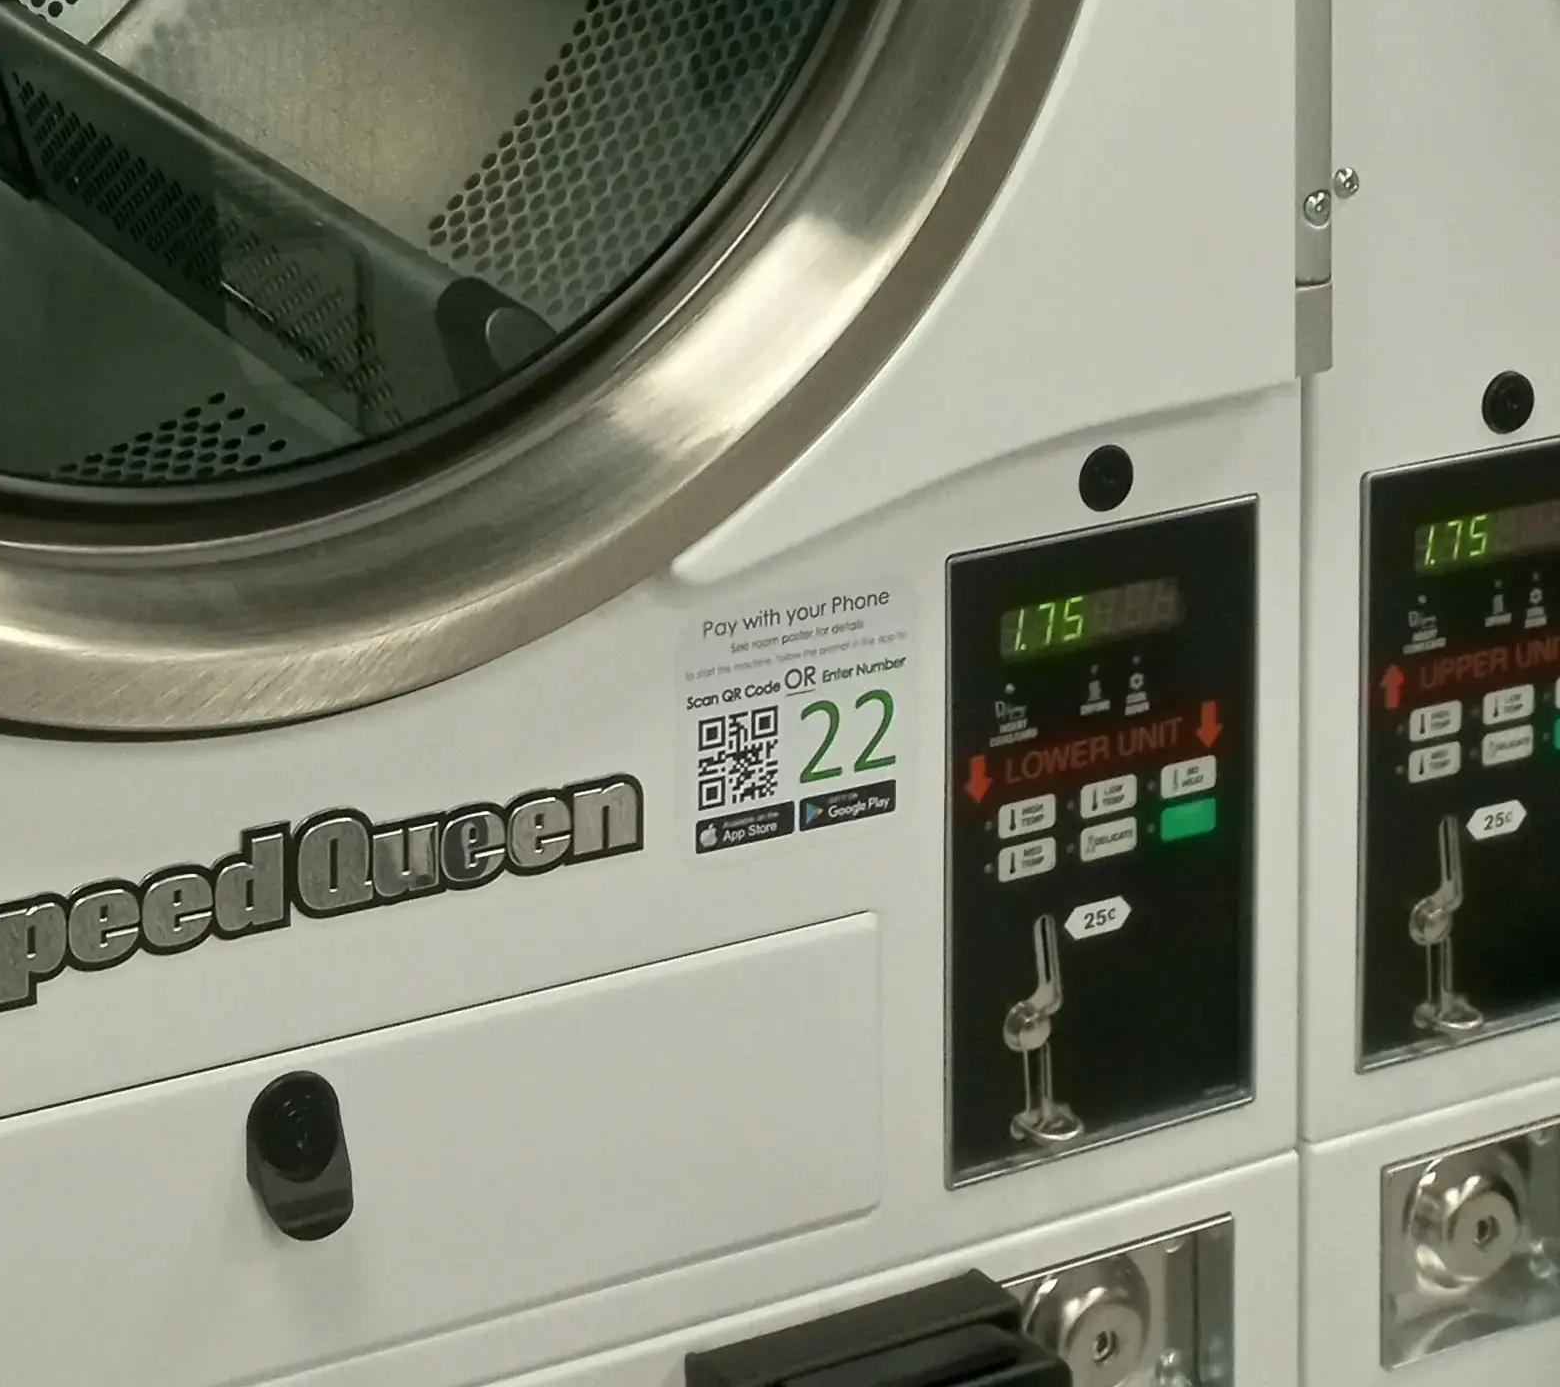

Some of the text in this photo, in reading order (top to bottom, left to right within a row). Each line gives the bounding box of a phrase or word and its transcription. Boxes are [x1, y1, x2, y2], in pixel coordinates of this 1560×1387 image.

[1423, 513, 1489, 566] 1.75
[703, 591, 890, 639] Pay with your Phone
[1014, 595, 1084, 652] 1.75
[686, 656, 907, 710] Scan QR Code OR Enter Number
[800, 689, 897, 784] 22
[1006, 735, 1111, 784] LOWER
[1119, 716, 1183, 757] UNIT
[722, 821, 778, 843] App Store
[828, 800, 867, 818] Google
[868, 796, 891, 808] Play
